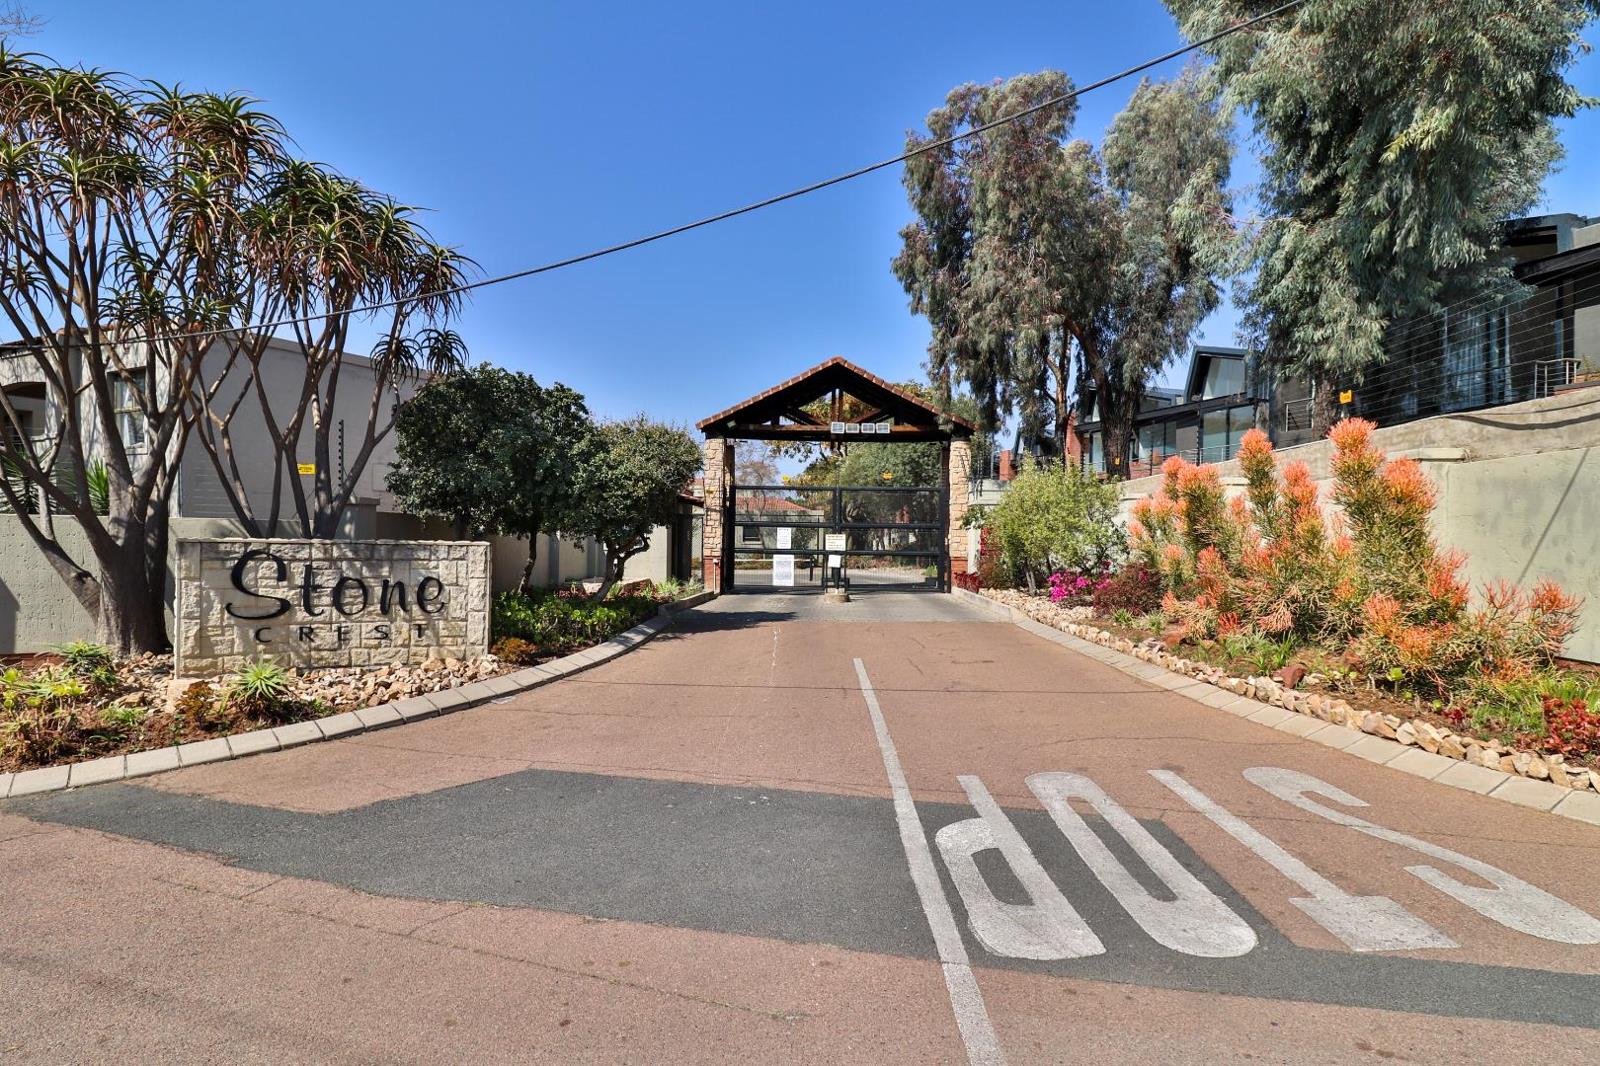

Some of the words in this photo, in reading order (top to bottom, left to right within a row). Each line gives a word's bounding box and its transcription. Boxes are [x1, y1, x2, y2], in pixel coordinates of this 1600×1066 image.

[226, 550, 446, 620] Stone
[255, 625, 428, 643] CREST
[935, 767, 1600, 961] STOP
